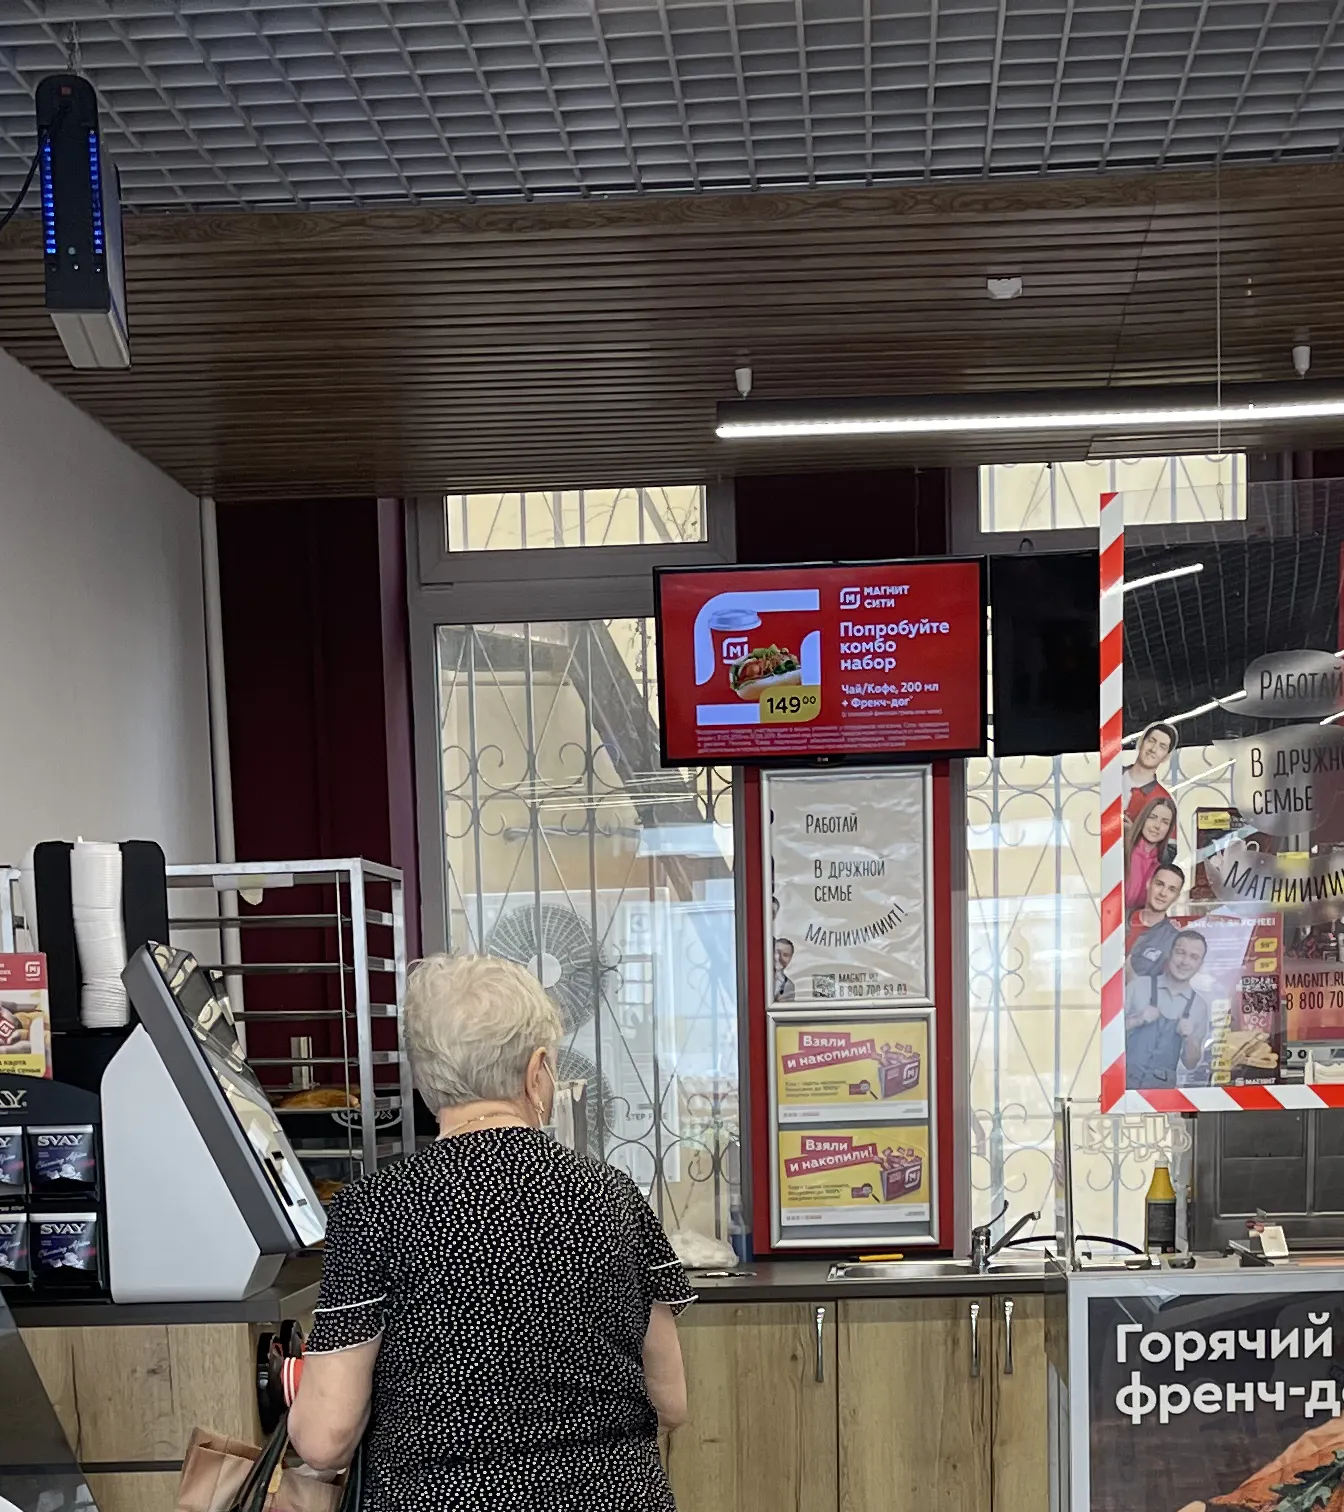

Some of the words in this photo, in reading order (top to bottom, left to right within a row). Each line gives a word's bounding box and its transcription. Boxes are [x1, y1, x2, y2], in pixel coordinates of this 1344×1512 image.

[864, 585, 910, 596] МАГНИТ
[864, 599, 895, 608] СИТИ
[840, 619, 950, 638] Попробуйте
[840, 638, 896, 654] комбо
[840, 655, 896, 672] набор
[841, 683, 899, 695] Чай/Кофе,
[900, 682, 922, 692] 200
[924, 683, 939, 692] мл
[767, 696, 801, 714] 149
[1251, 747, 1263, 778] В
[1252, 785, 1313, 815] СЕМЬЕ
[814, 859, 823, 878] В
[828, 857, 886, 879] ДРУЖНОЙ
[814, 885, 853, 902] СЕМЬЕ
[1285, 994, 1293, 1010] 8
[1299, 992, 1324, 1010] 800
[803, 1035, 846, 1047] Взяли
[787, 1059, 796, 1068] и
[799, 1042, 872, 1066] накопили!
[37, 1135, 83, 1147] SVAY
[805, 1139, 848, 1151] Взяли
[790, 1163, 799, 1172] и
[802, 1146, 874, 1170] накопили!
[40, 1223, 86, 1235] SVAY
[1115, 1312, 1334, 1371] Горячий
